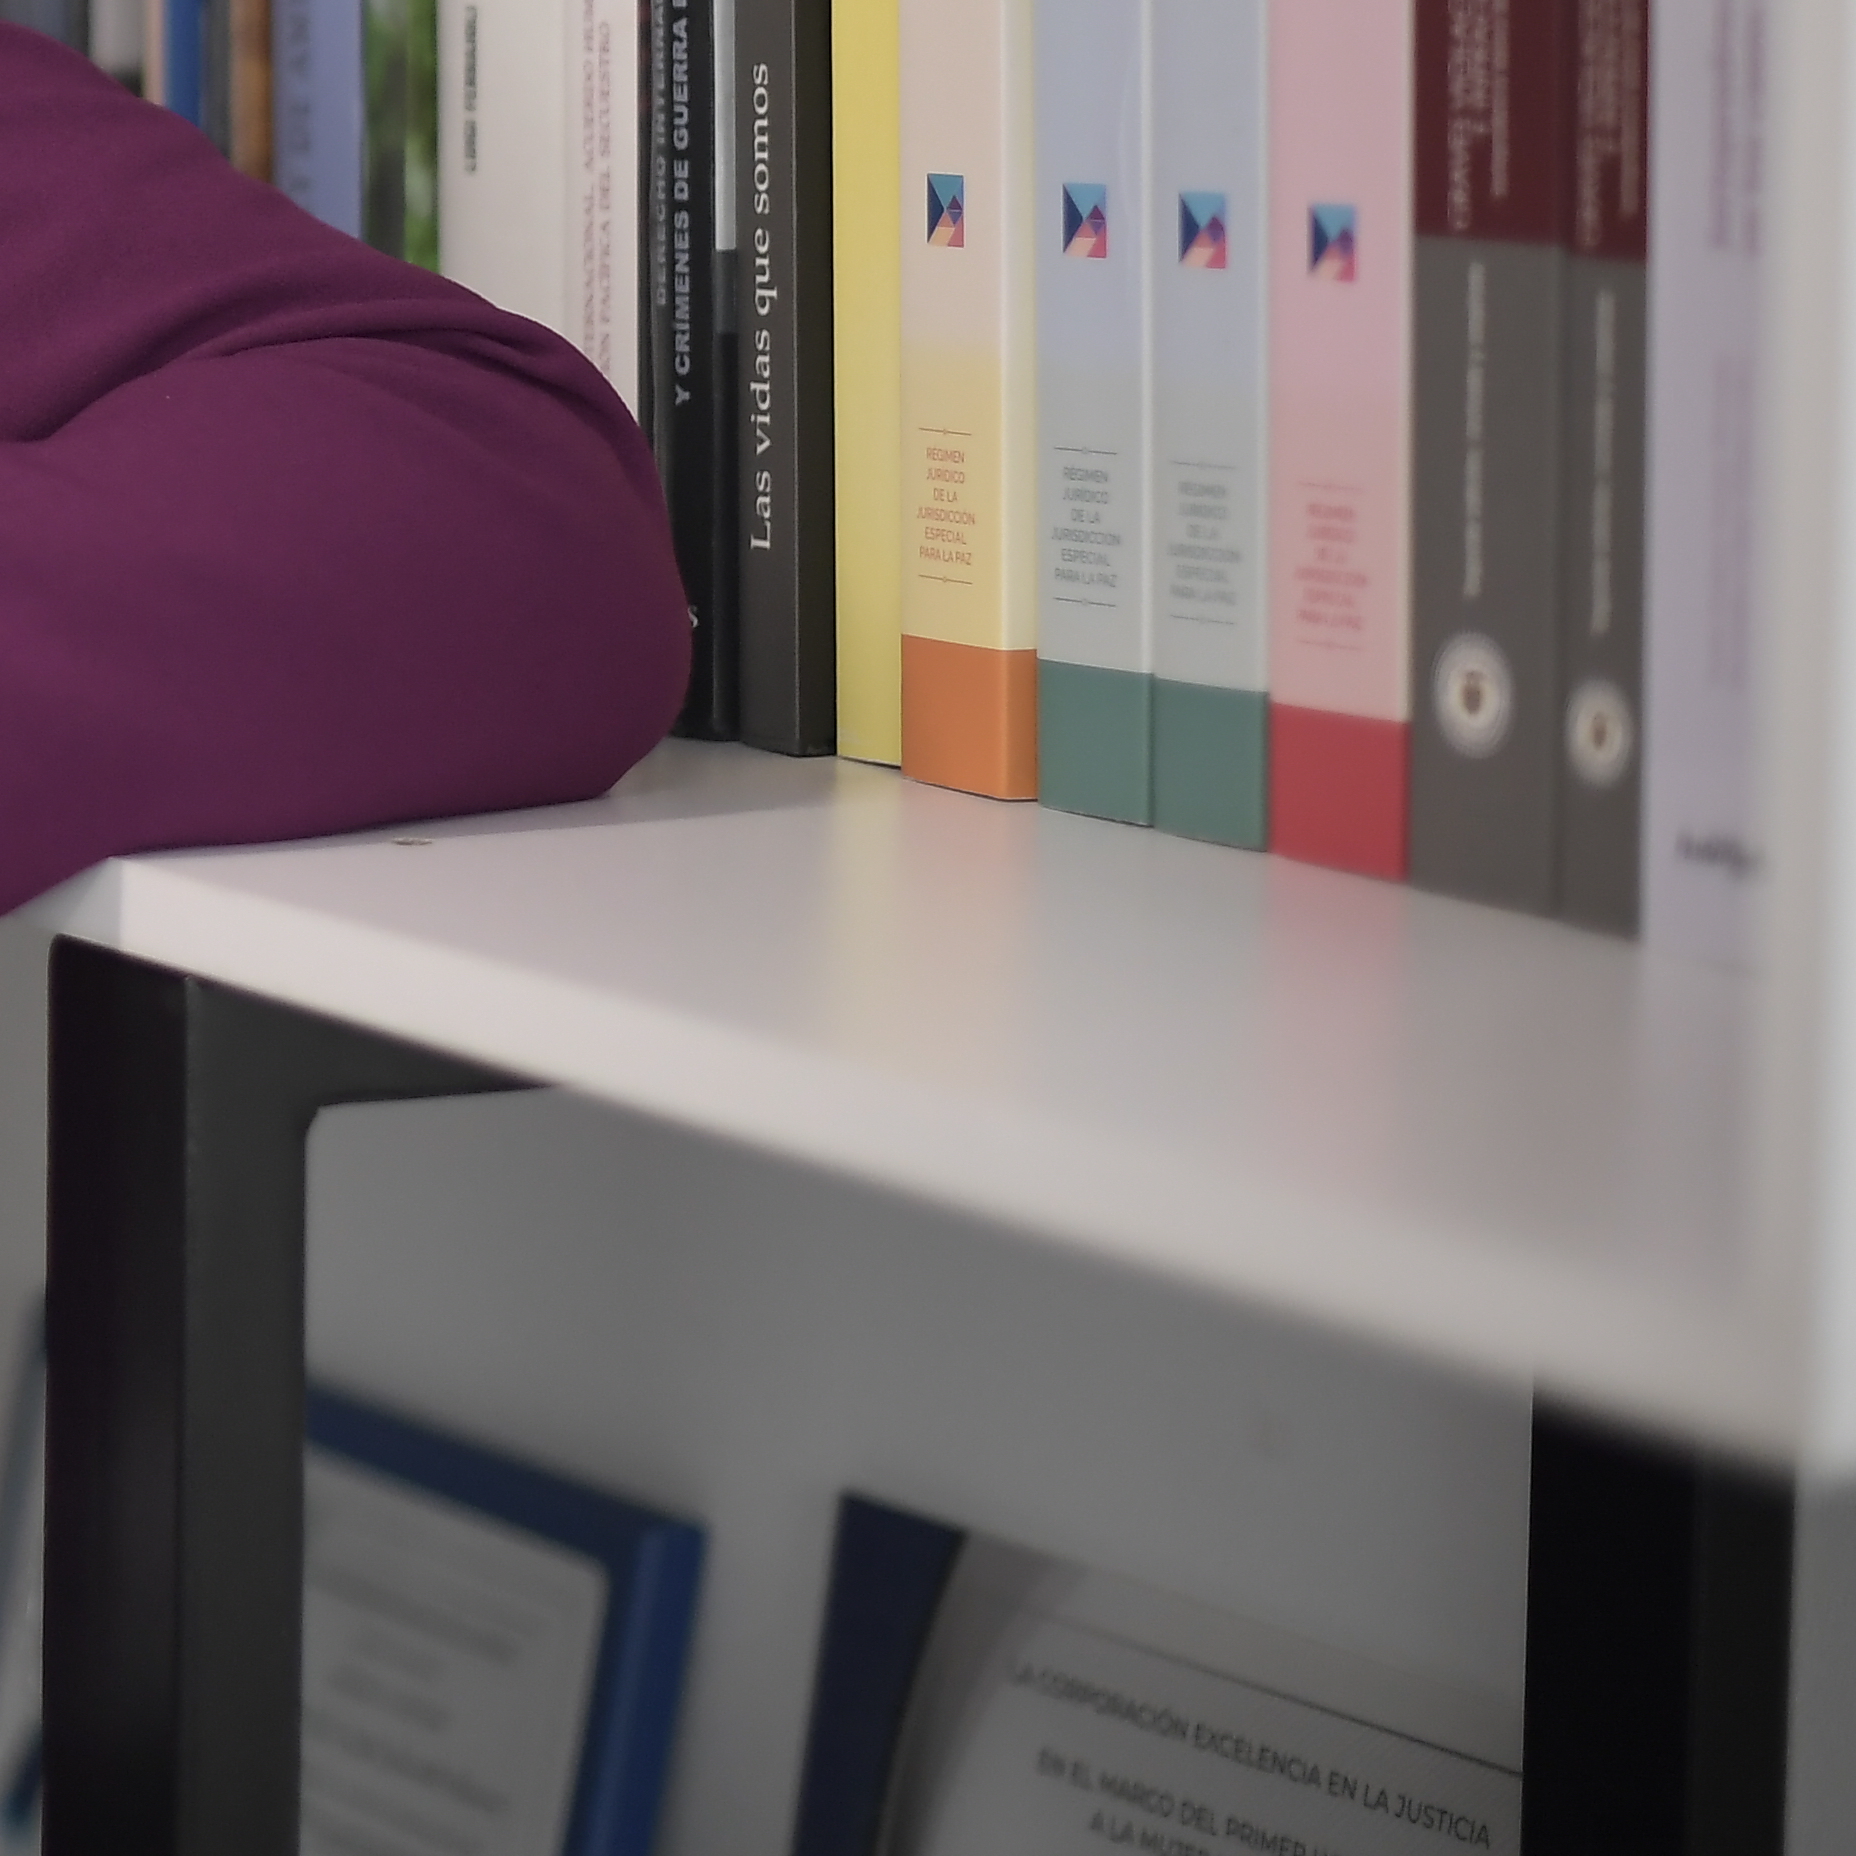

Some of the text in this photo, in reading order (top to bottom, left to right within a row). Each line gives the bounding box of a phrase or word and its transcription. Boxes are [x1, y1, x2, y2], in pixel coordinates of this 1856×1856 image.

[672, 18, 689, 151] GUERRA
[674, 159, 689, 201] DE
[655, 156, 667, 305] DERECHO
[749, 63, 778, 551] Las vidas que somos
[674, 383, 689, 406] Y
[933, 487, 958, 502] DE LA
[1071, 508, 1100, 524] DE LA
[924, 526, 967, 545] ESPECIAL
[919, 545, 972, 566] PARA LA PAZ
[1061, 547, 1110, 567] ESPECIAL
[1194, 1722, 1321, 1789] EXCELENCIA
[1328, 1770, 1358, 1800] EN
[1363, 1783, 1389, 1814] LA
[1394, 1794, 1491, 1850] JUSTICIA
[1099, 1771, 1175, 1818] MARCO
[1181, 1799, 1219, 1836] DEL
[1109, 1814, 1135, 1844] LA
